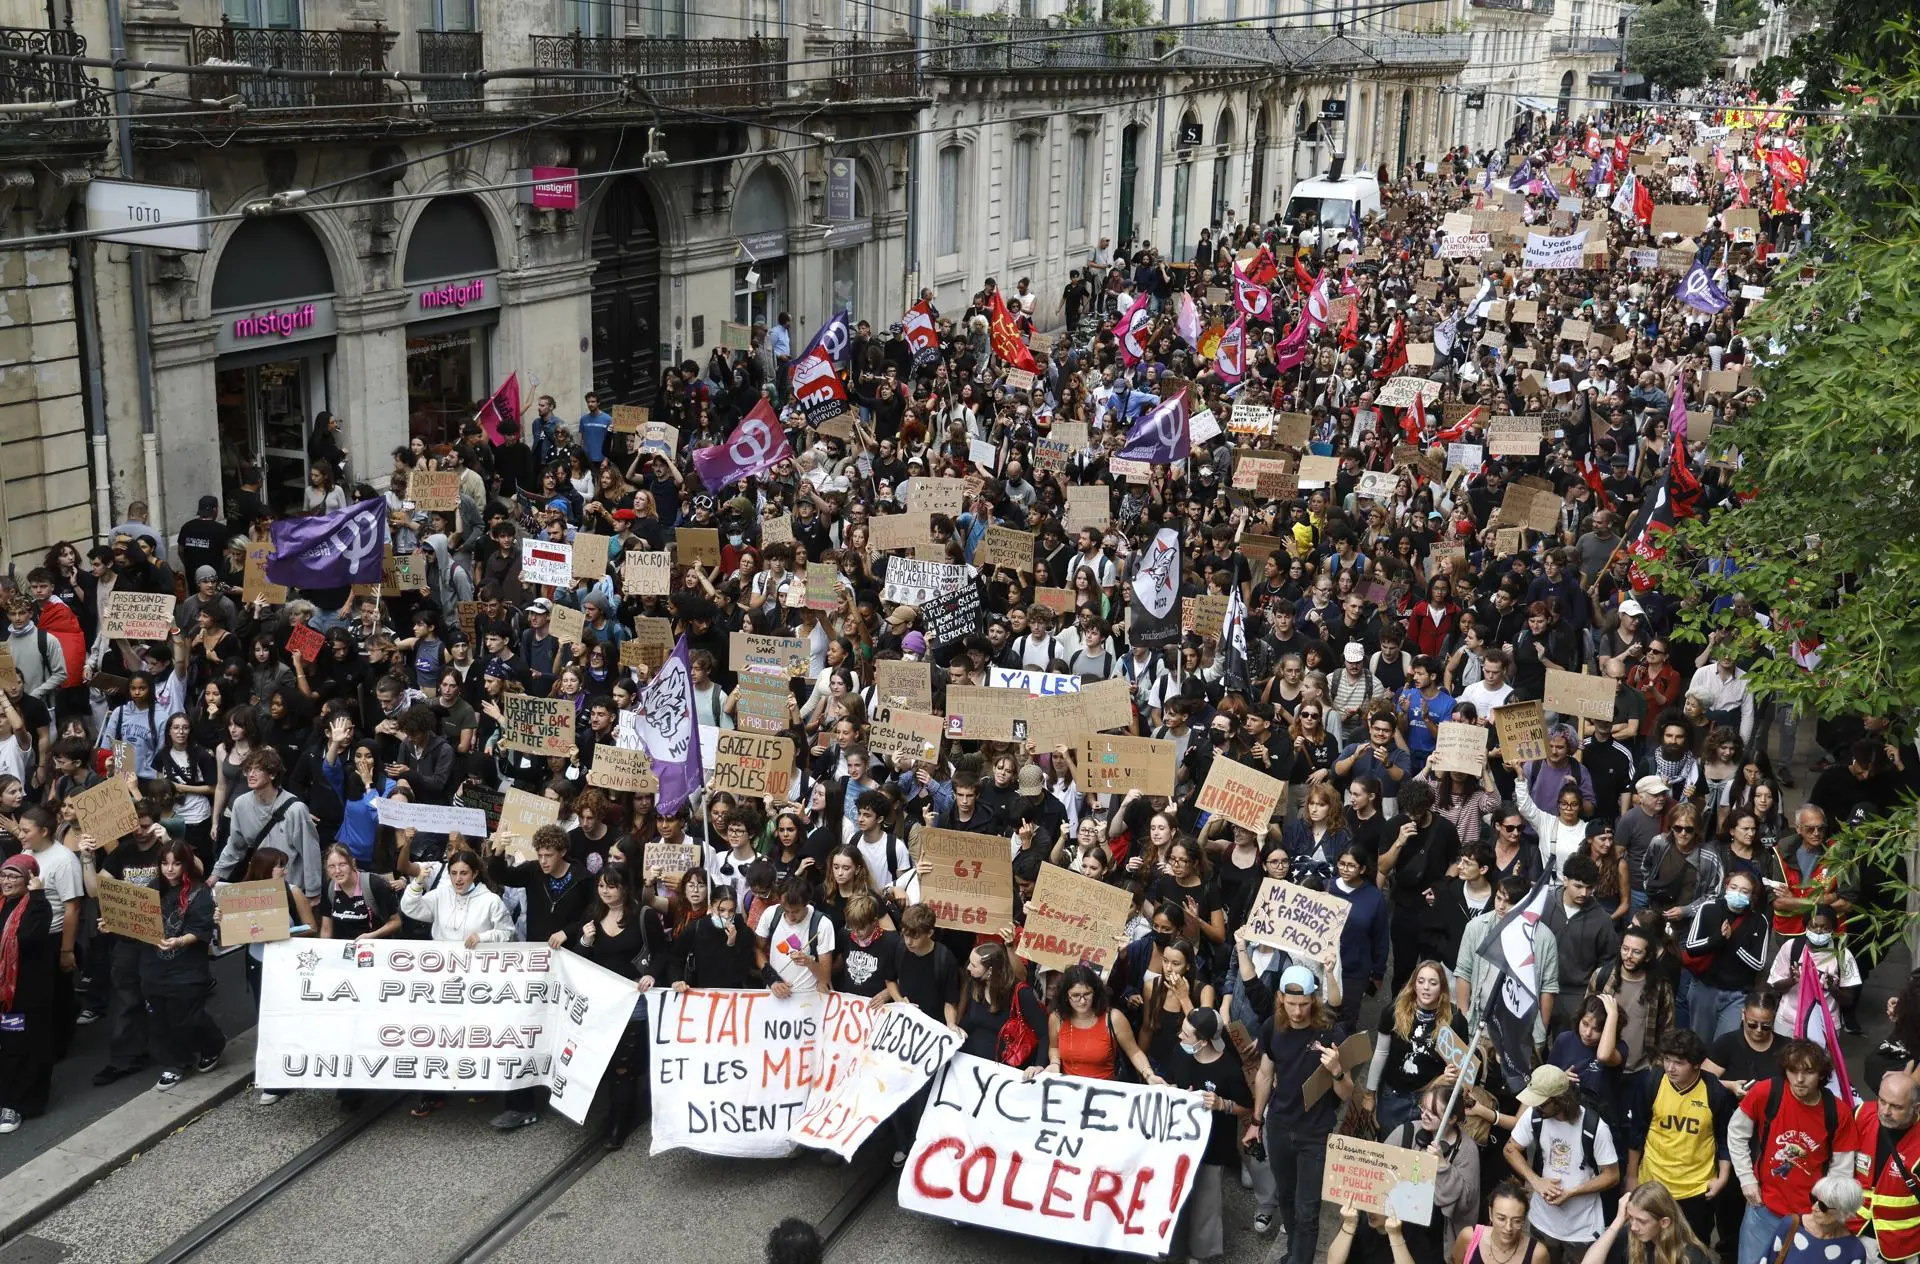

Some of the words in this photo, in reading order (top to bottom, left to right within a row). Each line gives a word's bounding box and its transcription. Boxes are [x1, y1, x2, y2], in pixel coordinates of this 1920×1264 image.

[535, 182, 573, 193] mistigriff
[127, 205, 160, 223] TOTO
[1526, 247, 1551, 256] Jules
[1542, 240, 1571, 248] Lycée
[421, 279, 485, 309] mistigriff
[235, 304, 315, 337] mistigriff
[987, 528, 1001, 537] NOS
[523, 555, 537, 567] SUR
[628, 553, 670, 567] MACRON
[899, 558, 940, 576] POUBELLES
[942, 565, 966, 577] SONT
[113, 594, 128, 603] PAS
[128, 594, 154, 604] BESOIN
[155, 595, 166, 604] DE
[921, 600, 938, 612] VOUS
[940, 592, 954, 604] VOUS
[152, 604, 165, 613] JE
[928, 606, 946, 618] PLUS
[107, 621, 124, 632] PAR
[936, 613, 953, 624] MOINS
[938, 621, 954, 632] PEUT
[954, 616, 966, 627] PAS
[124, 629, 165, 638] NATIONALE
[746, 637, 760, 645] PAS
[761, 638, 772, 646] DE
[773, 639, 803, 649] FUTUR
[755, 646, 776, 655] SANS
[745, 654, 782, 665] CULTURE
[1000, 671, 1030, 688] Y'A
[1040, 674, 1081, 696] LES
[506, 696, 520, 710] LES
[520, 696, 558, 715] LYCÉENS
[506, 710, 533, 723] VISENT
[533, 712, 545, 723] LE
[548, 714, 571, 728] BAC
[747, 717, 784, 731] PUBLIQUE
[873, 707, 891, 724] LA
[1501, 710, 1516, 721] VOS
[507, 720, 519, 731] LA
[520, 721, 535, 734] BAC
[539, 725, 560, 737] VISE
[507, 731, 518, 741] LA
[898, 731, 909, 741] au
[717, 736, 754, 757] GAZEZ
[755, 740, 783, 762] LES
[869, 740, 887, 755] pas
[614, 765, 647, 776] MARCHE
[714, 762, 740, 789] PAS
[739, 770, 766, 794] LES
[765, 770, 789, 796] ADO
[1101, 767, 1120, 779] BAC
[590, 773, 649, 789] CONNARD
[1199, 784, 1217, 808] EN
[1216, 790, 1266, 826] MARCHE
[953, 860, 983, 879] 67
[927, 898, 959, 921] MAI
[961, 906, 989, 926] 68
[1269, 885, 1287, 901] MA
[1290, 892, 1338, 926] FRANCE
[1276, 906, 1329, 938] FASHION
[1253, 920, 1279, 938] PAS
[1281, 924, 1323, 956] FACHO
[386, 947, 552, 973] CONTRE
[300, 977, 360, 1002] LA
[378, 975, 590, 1026] PRÉCARITÉ
[377, 1022, 543, 1049] COMBAT
[764, 1017, 817, 1041] NOUS
[871, 1010, 953, 1078] DESSUS
[282, 1052, 568, 1100] UNIVERSITAIE
[660, 1057, 690, 1084] ET
[703, 1059, 748, 1085] LES
[1659, 1114, 1700, 1136] JVC
[1034, 1128, 1084, 1158] EN
[1331, 1163, 1346, 1173] UN
[1347, 1166, 1386, 1181] SERVICE
[1329, 1187, 1342, 1197] DE
[1342, 1177, 1373, 1190] PUBLIC
